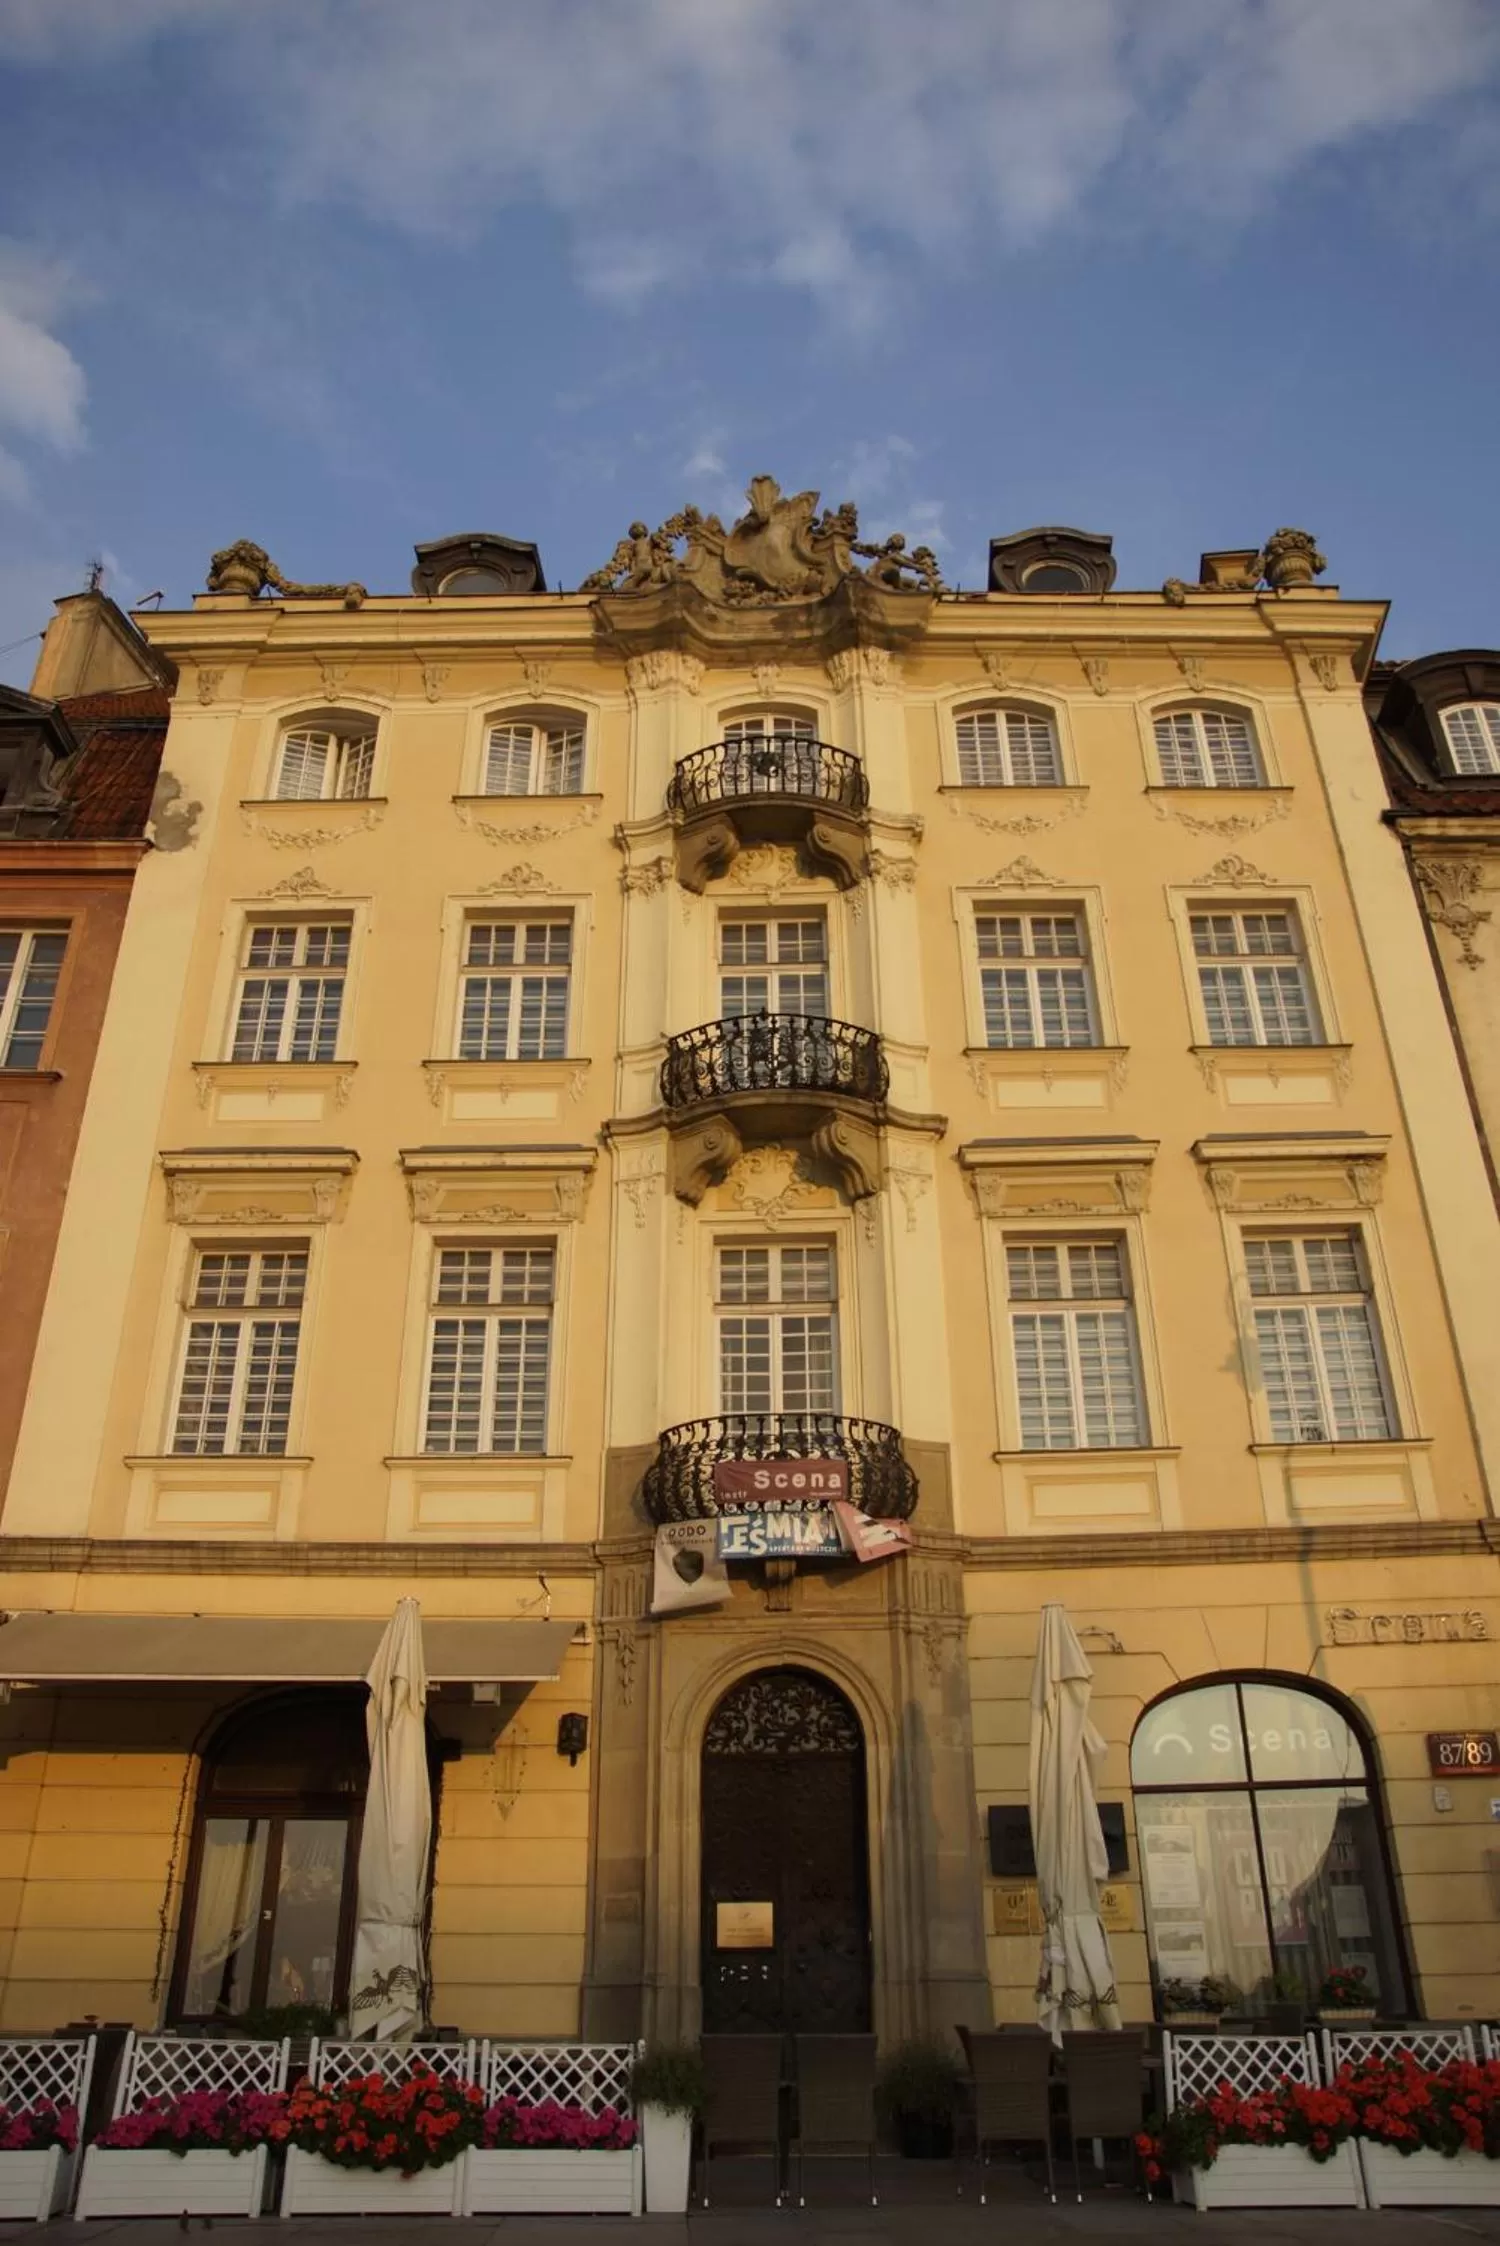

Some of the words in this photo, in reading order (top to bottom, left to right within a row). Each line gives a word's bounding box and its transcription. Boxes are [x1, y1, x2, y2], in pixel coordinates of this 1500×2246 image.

[754, 1470, 841, 1489] Scena
[1209, 1723, 1332, 1752] Scena
[1440, 1740, 1492, 1766] 87/89
